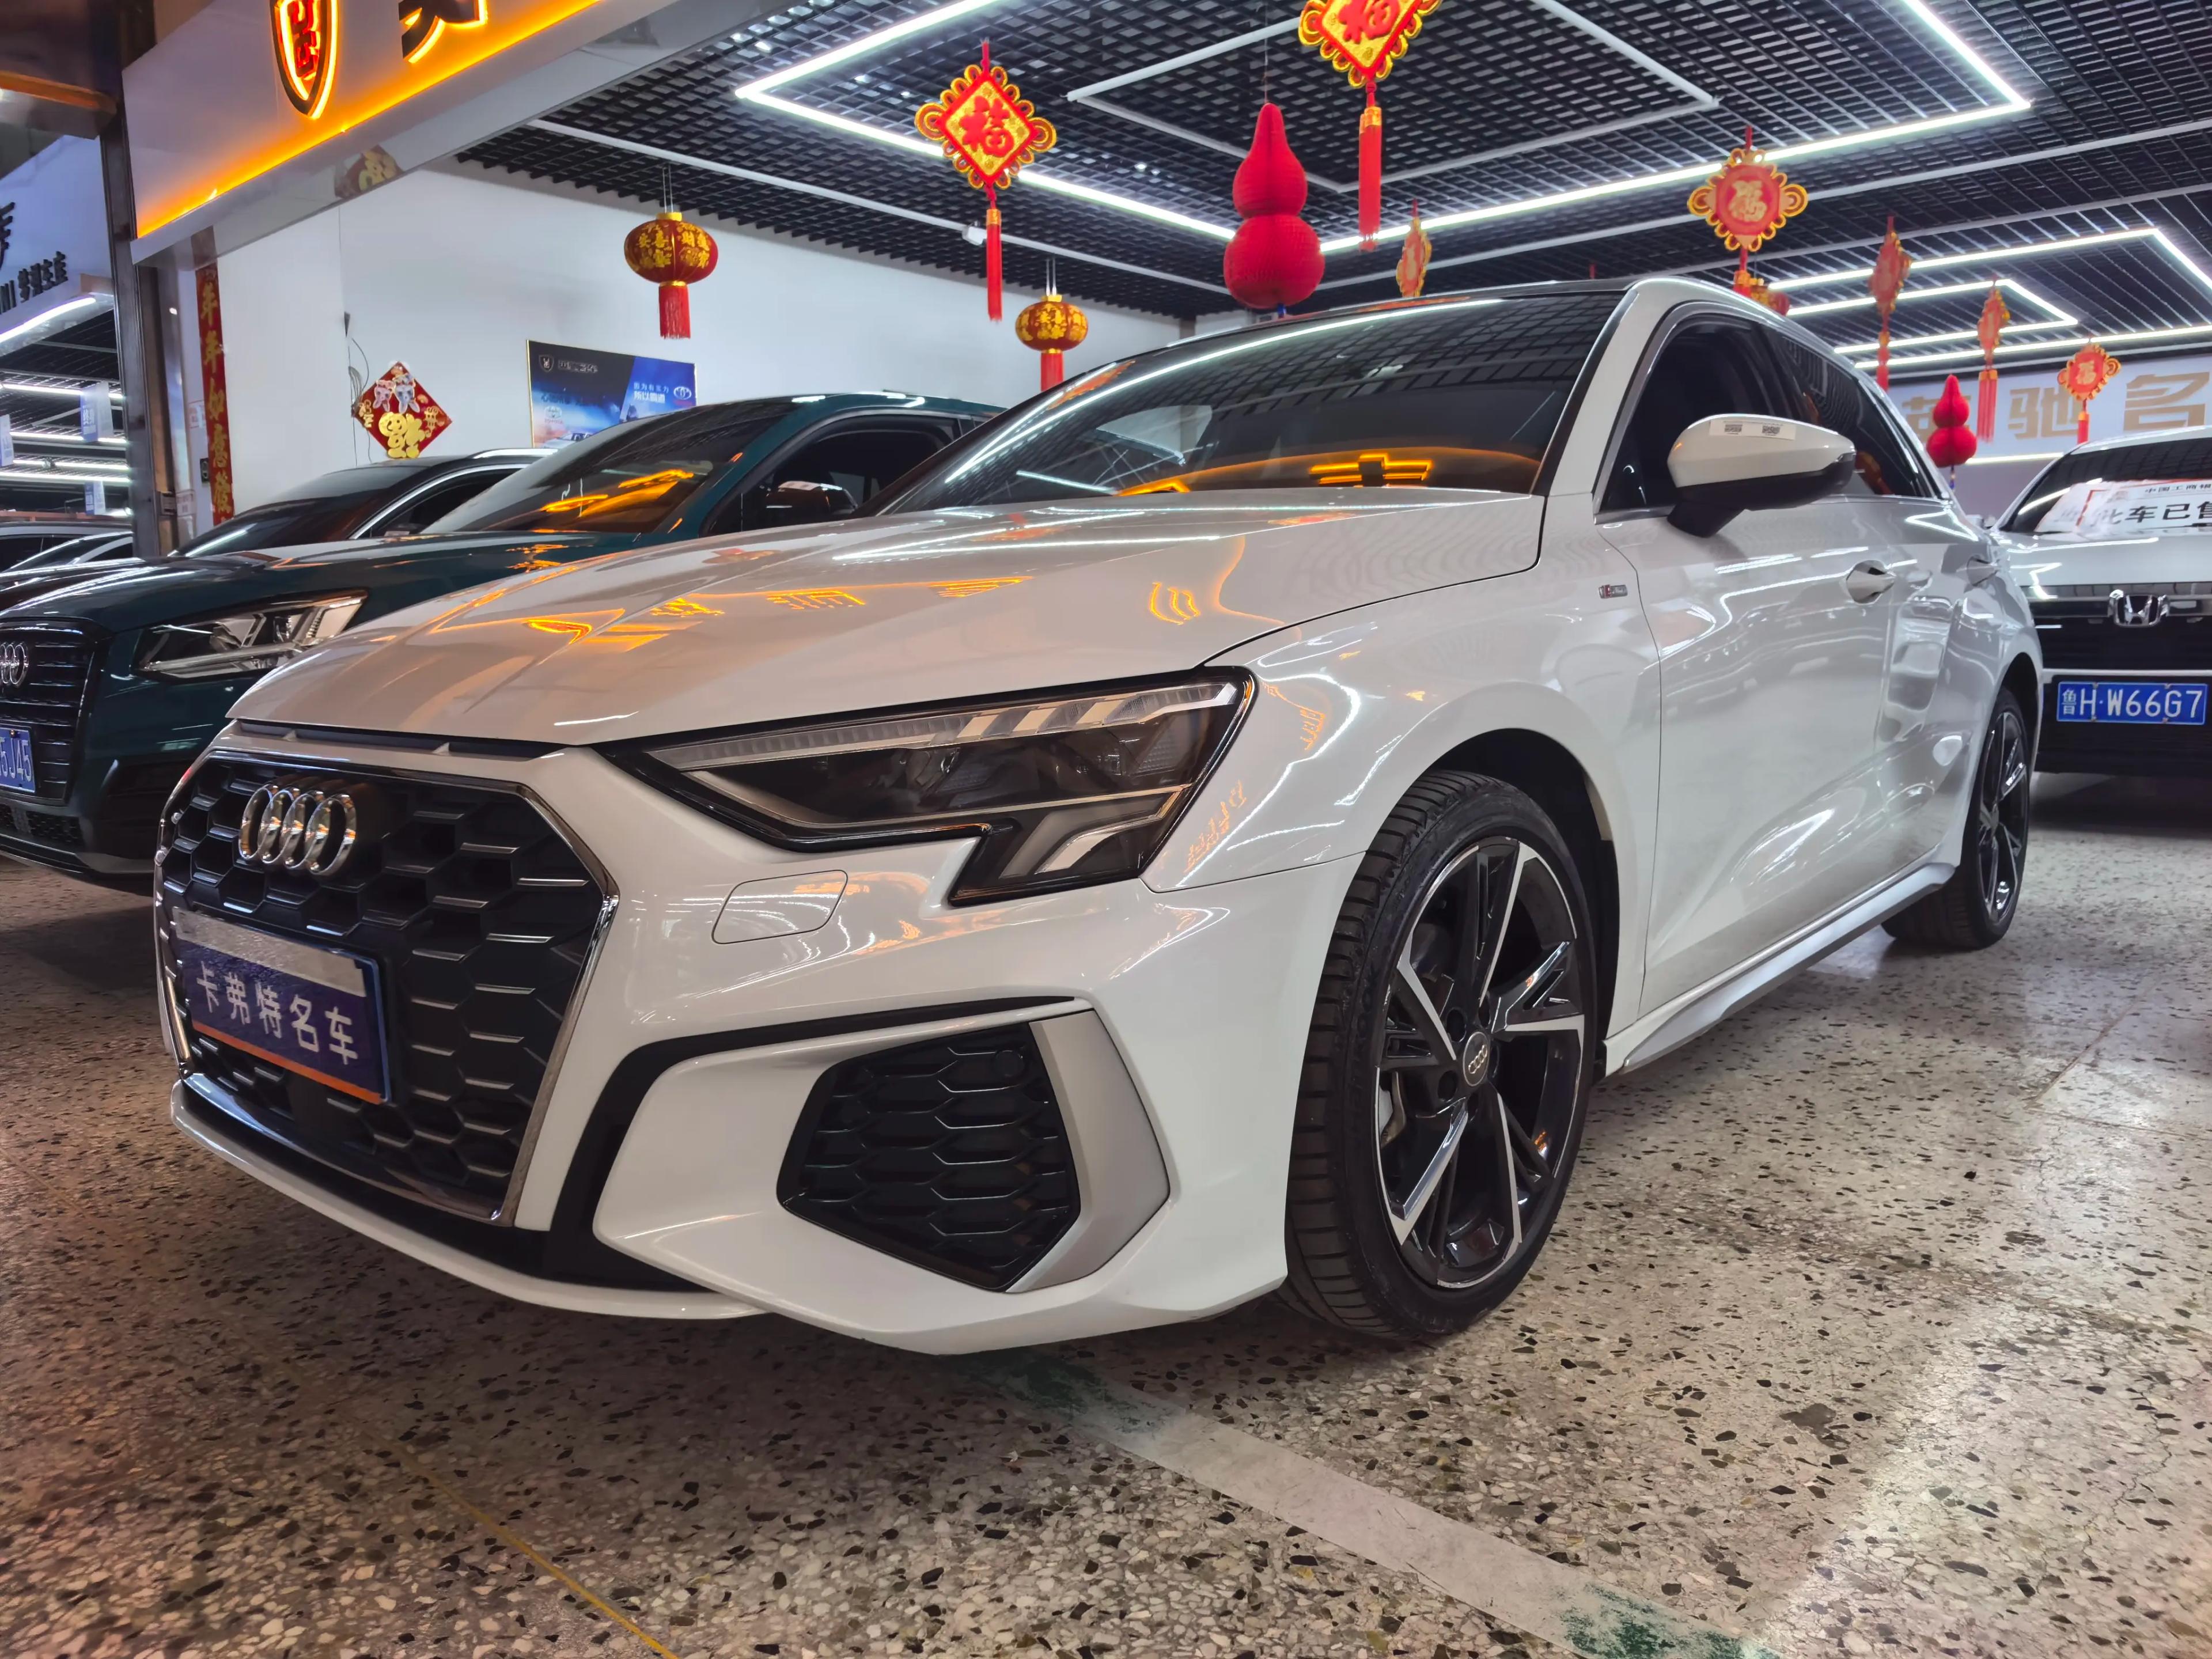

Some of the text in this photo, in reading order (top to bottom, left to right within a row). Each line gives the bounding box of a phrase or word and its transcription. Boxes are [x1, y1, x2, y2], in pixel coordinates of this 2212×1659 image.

[959, 96, 1015, 158] 福
[196, 960, 358, 1065] 卡弗特名车
